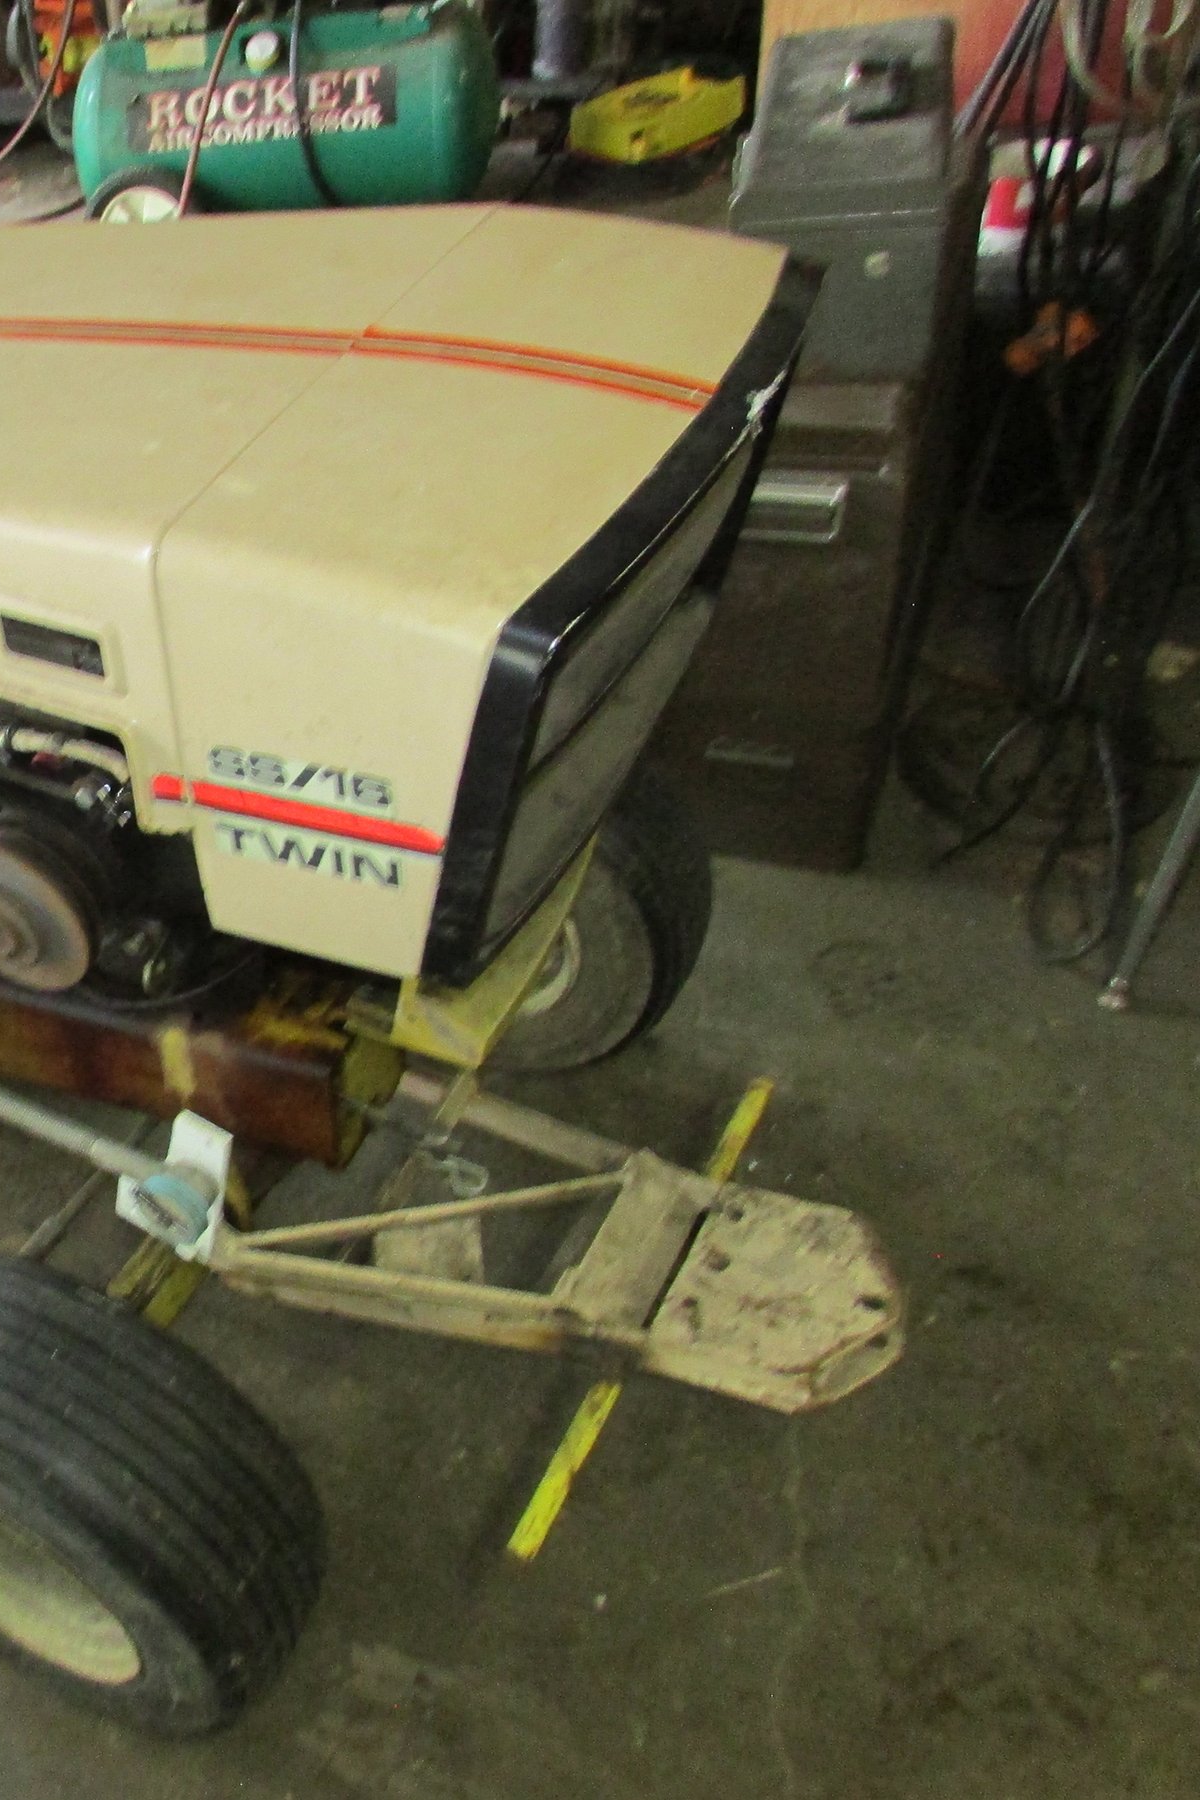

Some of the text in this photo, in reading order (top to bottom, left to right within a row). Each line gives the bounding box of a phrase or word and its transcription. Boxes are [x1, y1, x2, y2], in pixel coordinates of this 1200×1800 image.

[146, 66, 381, 131] ROCKET
[208, 745, 393, 808] SS/16
[217, 822, 400, 887] TWIN
